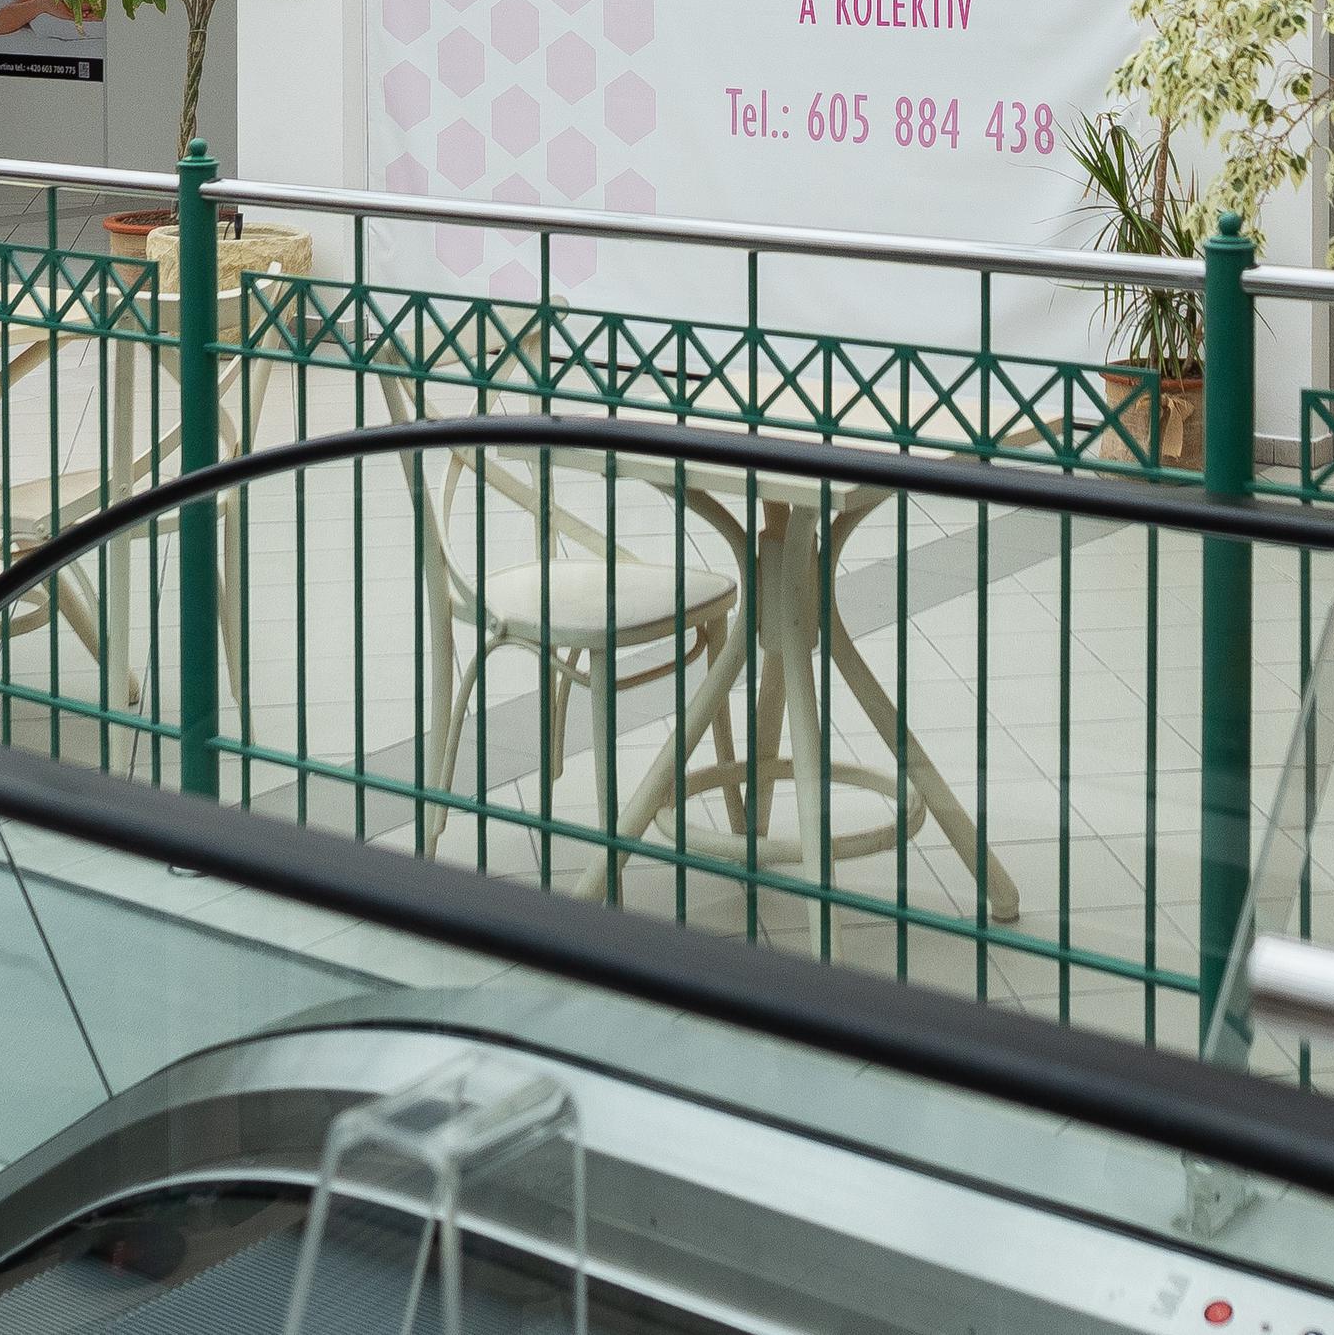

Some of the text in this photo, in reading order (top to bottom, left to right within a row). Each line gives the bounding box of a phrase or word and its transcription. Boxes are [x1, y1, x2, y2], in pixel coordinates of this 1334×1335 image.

[725, 88, 1055, 155] Tel.: 605 884 438
